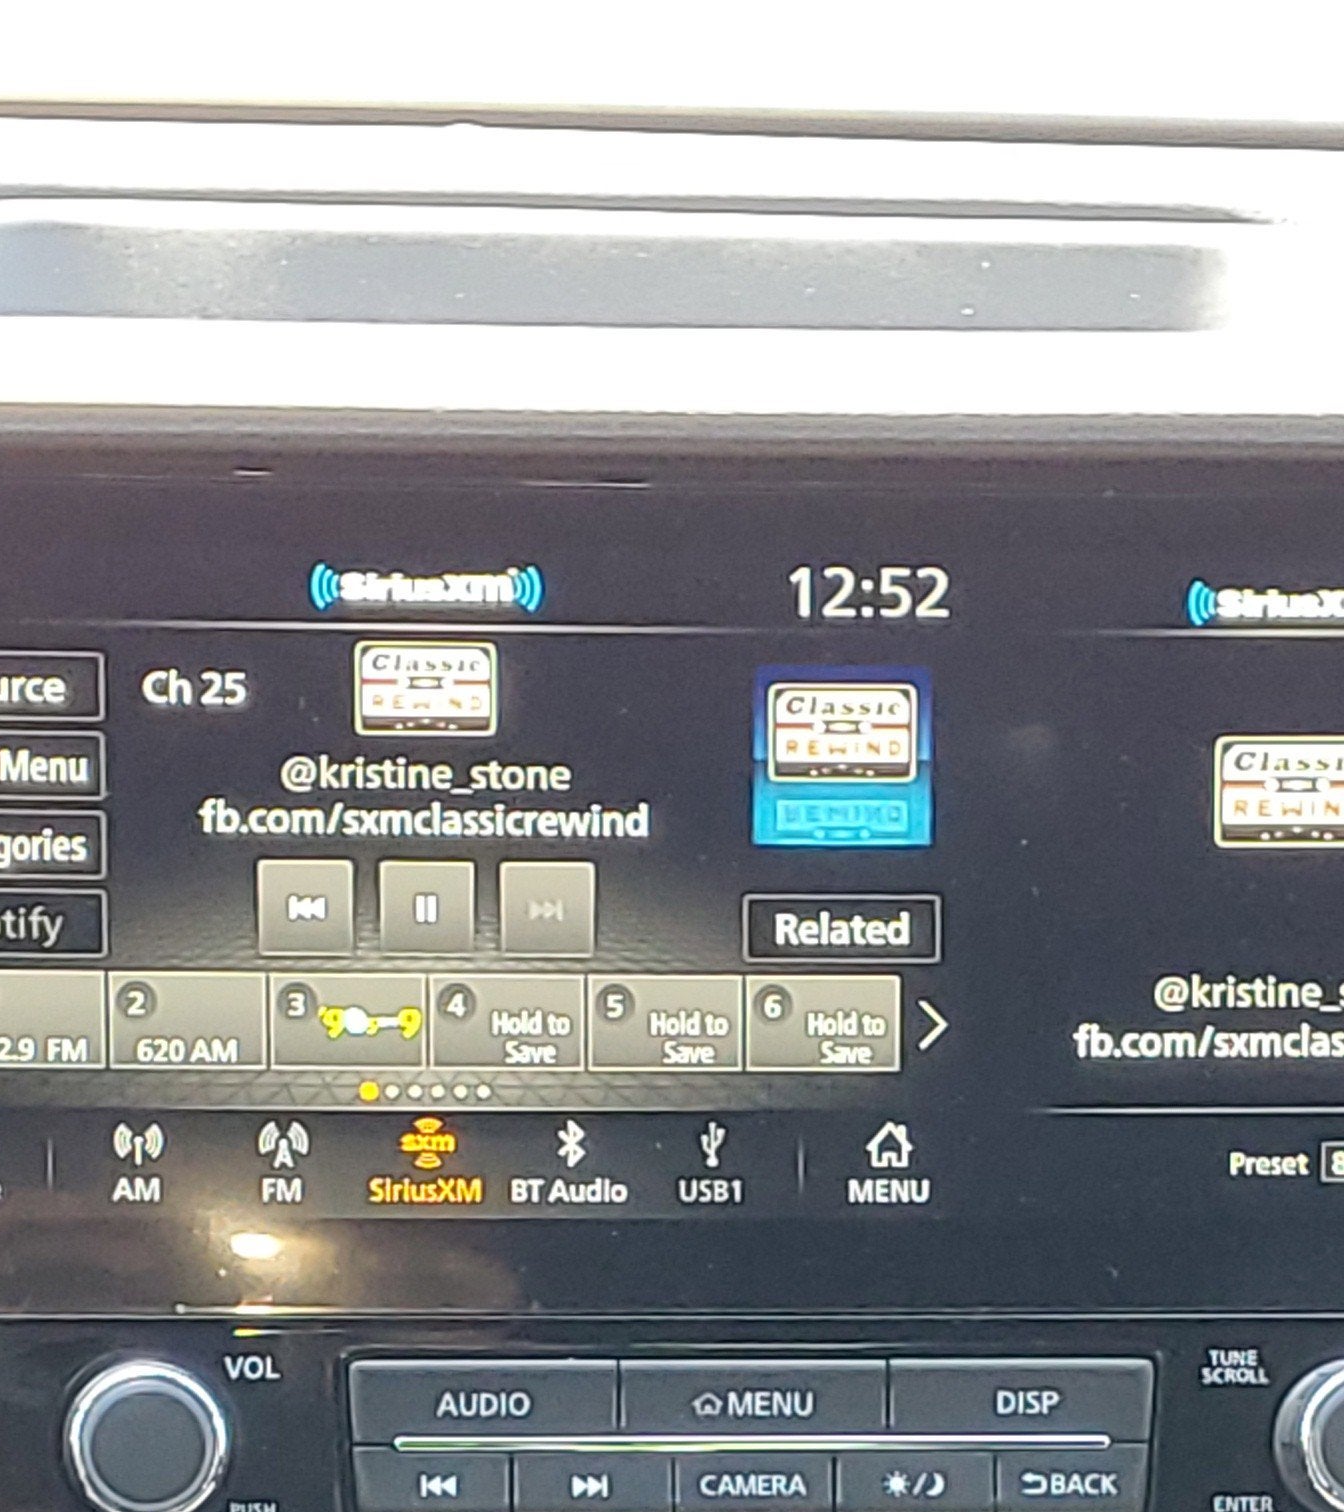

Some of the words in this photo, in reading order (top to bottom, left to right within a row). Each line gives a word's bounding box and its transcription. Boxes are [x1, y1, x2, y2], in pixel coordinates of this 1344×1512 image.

[788, 566, 951, 619] 12:52
[372, 654, 481, 672] Classic
[142, 669, 193, 704] Ch
[200, 671, 247, 705] 25
[786, 696, 901, 715] Classic
[280, 756, 572, 795] @kristine_stone
[198, 799, 650, 837] fb.com/sxmclassicrewind
[774, 910, 911, 947] Related
[126, 992, 147, 1016] 2
[287, 992, 306, 1017] 3
[446, 992, 466, 1018] 4
[605, 995, 624, 1018] 5
[763, 995, 782, 1018] 6
[491, 1011, 542, 1037] Hold
[546, 1013, 571, 1037] to
[649, 1011, 700, 1037] Hold
[705, 1013, 730, 1037] to
[807, 1011, 858, 1037] Hold
[862, 1013, 887, 1037] to
[47, 1038, 87, 1063] FM
[136, 1038, 186, 1063] 620
[190, 1038, 238, 1063] AM
[504, 1041, 557, 1064] Save
[662, 1042, 716, 1064] Save
[820, 1042, 873, 1064] Save
[1229, 1151, 1309, 1176] Preset
[112, 1177, 161, 1201] AM
[262, 1177, 303, 1201] FM
[368, 1176, 483, 1203] SiriusXM
[510, 1179, 544, 1203] BT
[547, 1178, 629, 1203] Audio
[679, 1179, 742, 1203] USB1
[848, 1179, 931, 1204] MENU
[223, 1355, 281, 1381] VOL
[1209, 1348, 1258, 1367] TUNE
[1201, 1366, 1269, 1385] SCROLL
[435, 1391, 531, 1418] AUDIO
[727, 1391, 814, 1417] MENU
[996, 1390, 1060, 1416] DISP
[699, 1473, 807, 1497] CAMERA
[1050, 1472, 1118, 1496] BACK
